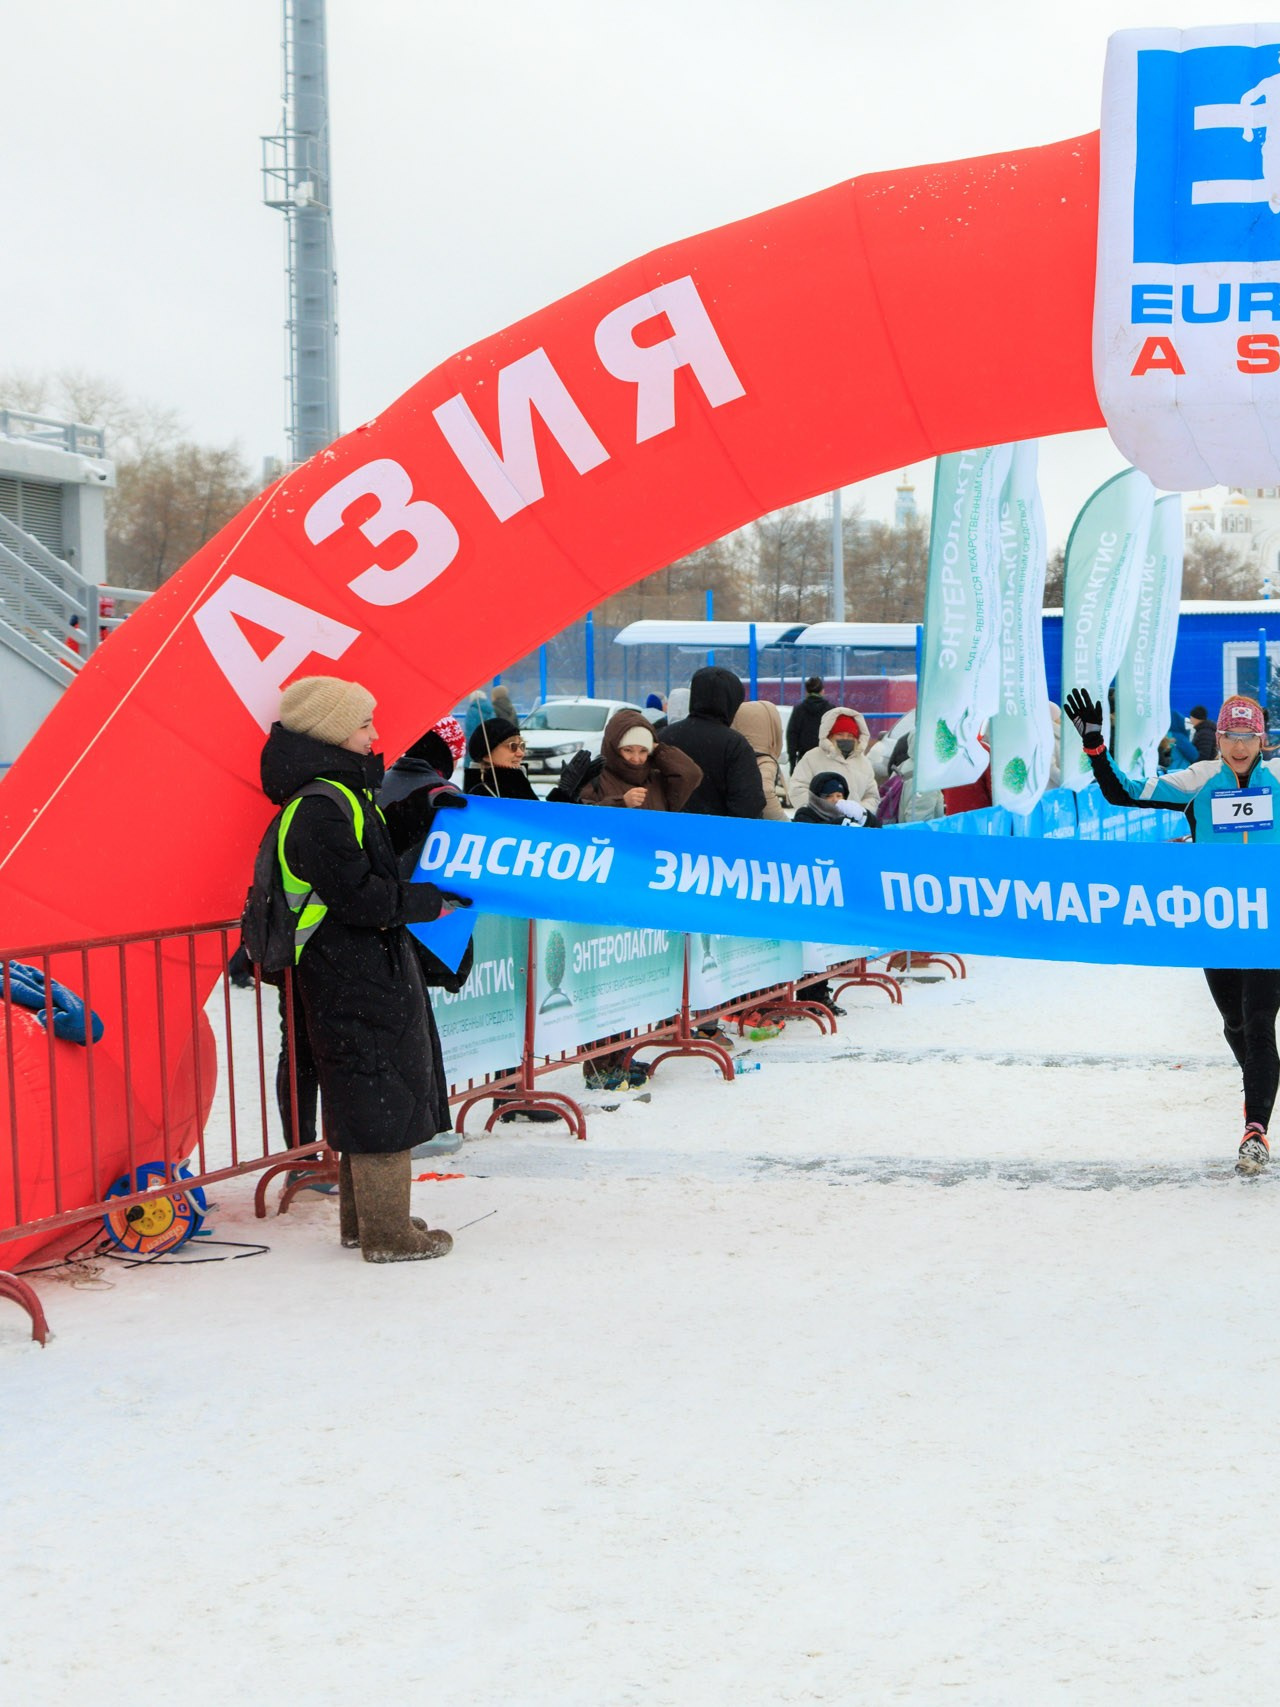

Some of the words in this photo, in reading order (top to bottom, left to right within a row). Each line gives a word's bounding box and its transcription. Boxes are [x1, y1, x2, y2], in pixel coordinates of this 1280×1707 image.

[193, 275, 747, 735] АЗИЯ
[1075, 531, 1118, 694] НТЕРОЛАКТИС
[1232, 803, 1253, 816] 76
[649, 850, 844, 907] ЗИМНИЙ
[880, 871, 1268, 930] ПОЛУМАРАФОН
[573, 929, 669, 974] ЭНТЕРОЛАКТИС
